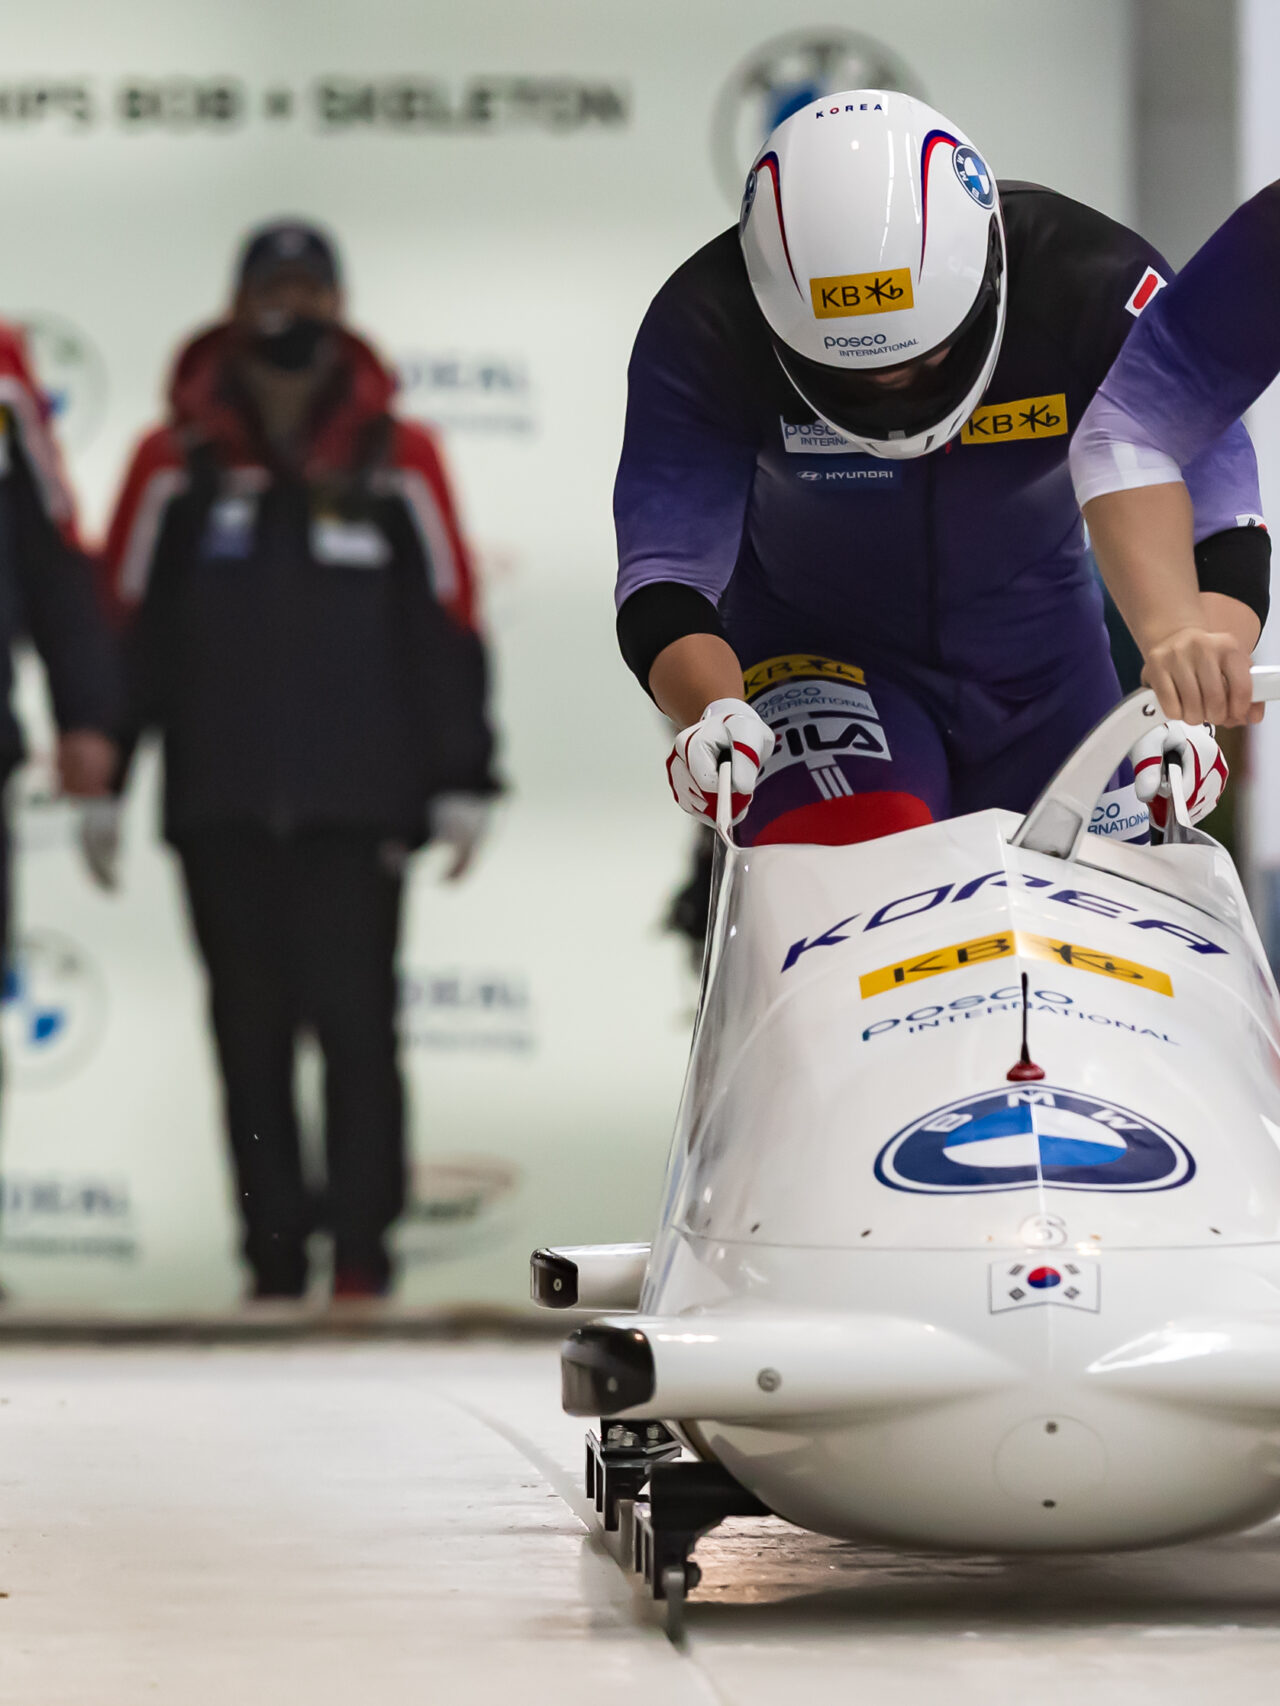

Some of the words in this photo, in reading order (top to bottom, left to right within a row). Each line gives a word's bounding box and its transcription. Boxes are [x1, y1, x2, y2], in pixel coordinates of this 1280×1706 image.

[815, 103, 883, 119] KOREA
[839, 338, 920, 358] INTERNATIONAL
[825, 470, 894, 481] HYUNDAI
[760, 694, 877, 720] NTERNATIONAL
[780, 869, 1230, 974] KOREA
[907, 1000, 1182, 1046] INTERNATIONAL
[920, 1088, 1147, 1134] BMW
